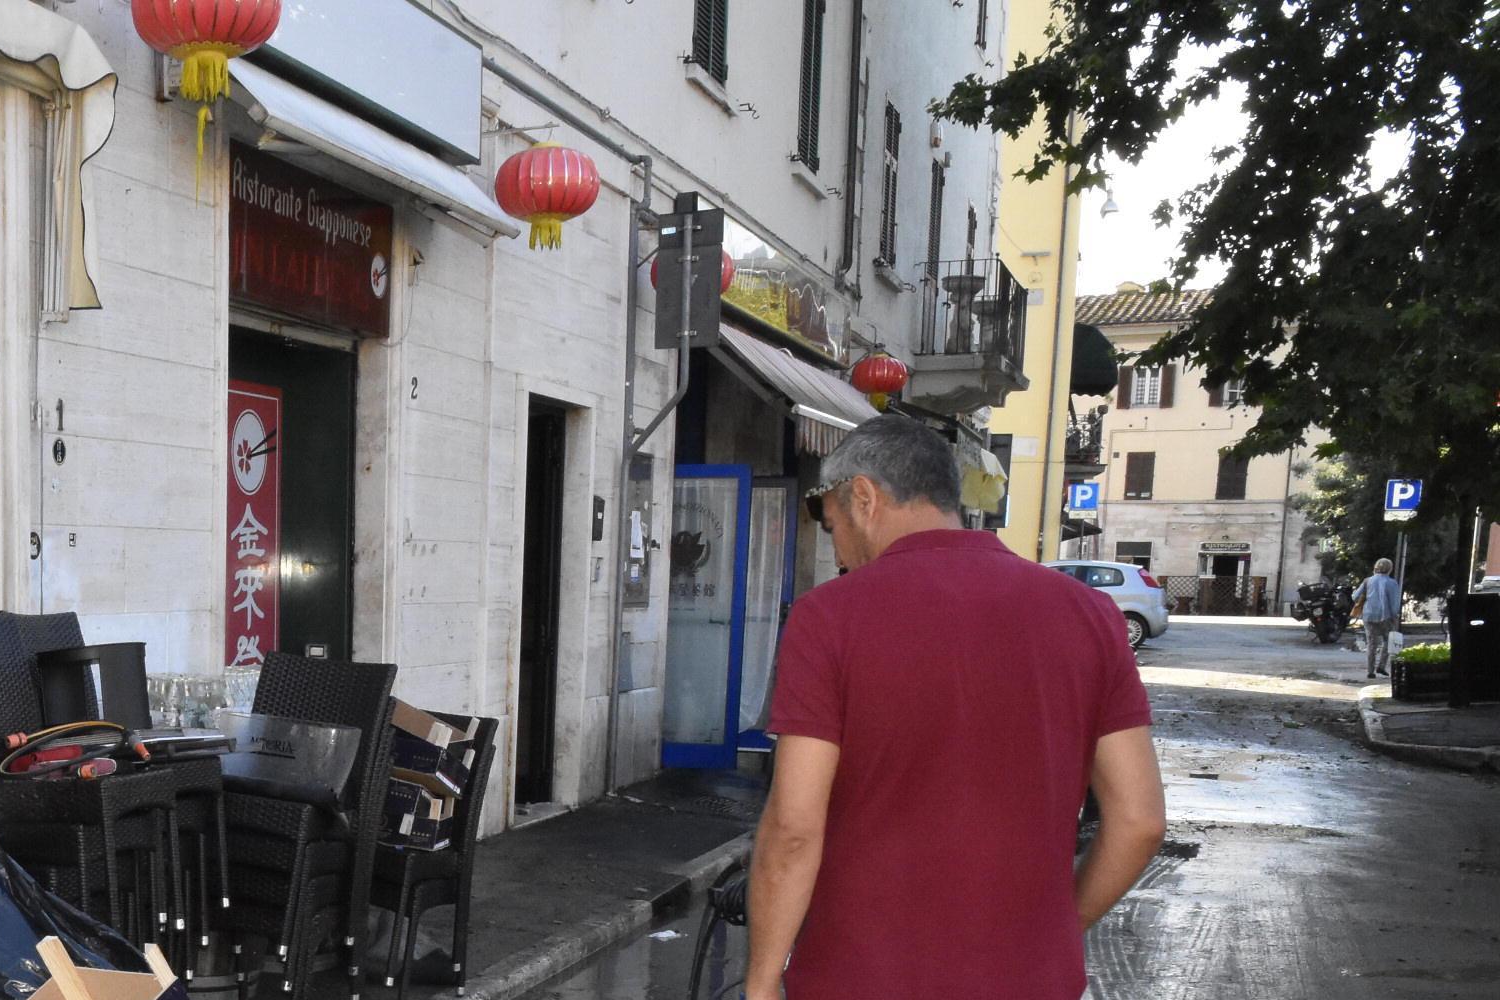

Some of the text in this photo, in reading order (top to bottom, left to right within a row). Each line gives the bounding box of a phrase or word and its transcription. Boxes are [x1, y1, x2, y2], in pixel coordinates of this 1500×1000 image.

[233, 157, 372, 248] Ristorante Giapponese
[410, 376, 418, 400] 2
[55, 398, 64, 431] 1
[1075, 485, 1093, 507] P
[1392, 483, 1415, 507] P
